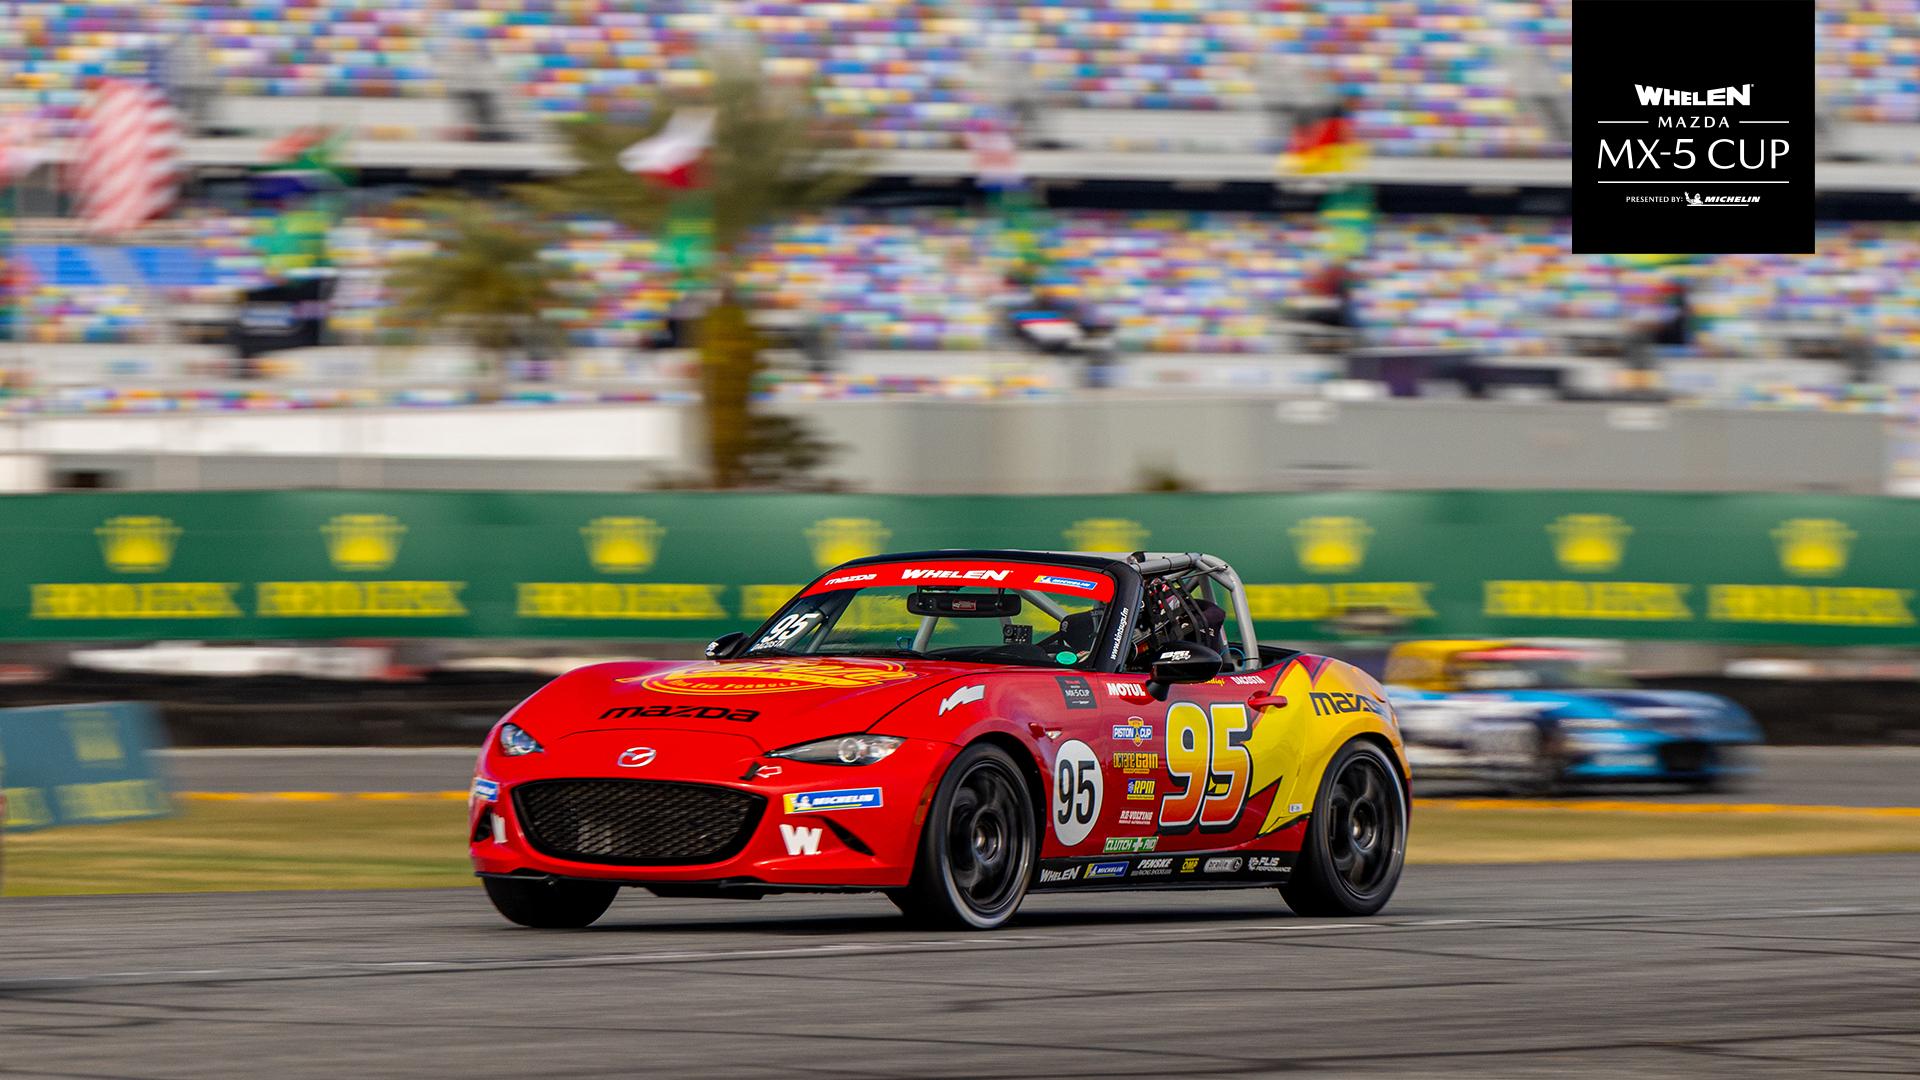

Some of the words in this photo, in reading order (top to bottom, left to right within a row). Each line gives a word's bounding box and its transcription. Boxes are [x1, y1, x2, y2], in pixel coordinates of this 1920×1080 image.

[901, 569, 1010, 581] WHELEN
[761, 612, 821, 643] 95
[1106, 682, 1146, 697] MOTUL
[1113, 727, 1134, 739] PISTON
[1139, 727, 1152, 739] CUP
[1159, 702, 1253, 832] 95
[1058, 759, 1095, 825] 95
[1133, 780, 1156, 794] RPM
[1105, 840, 1131, 851] CLUTCH
[1137, 858, 1174, 870] PENSKE
[1040, 865, 1082, 882] WHELEN
